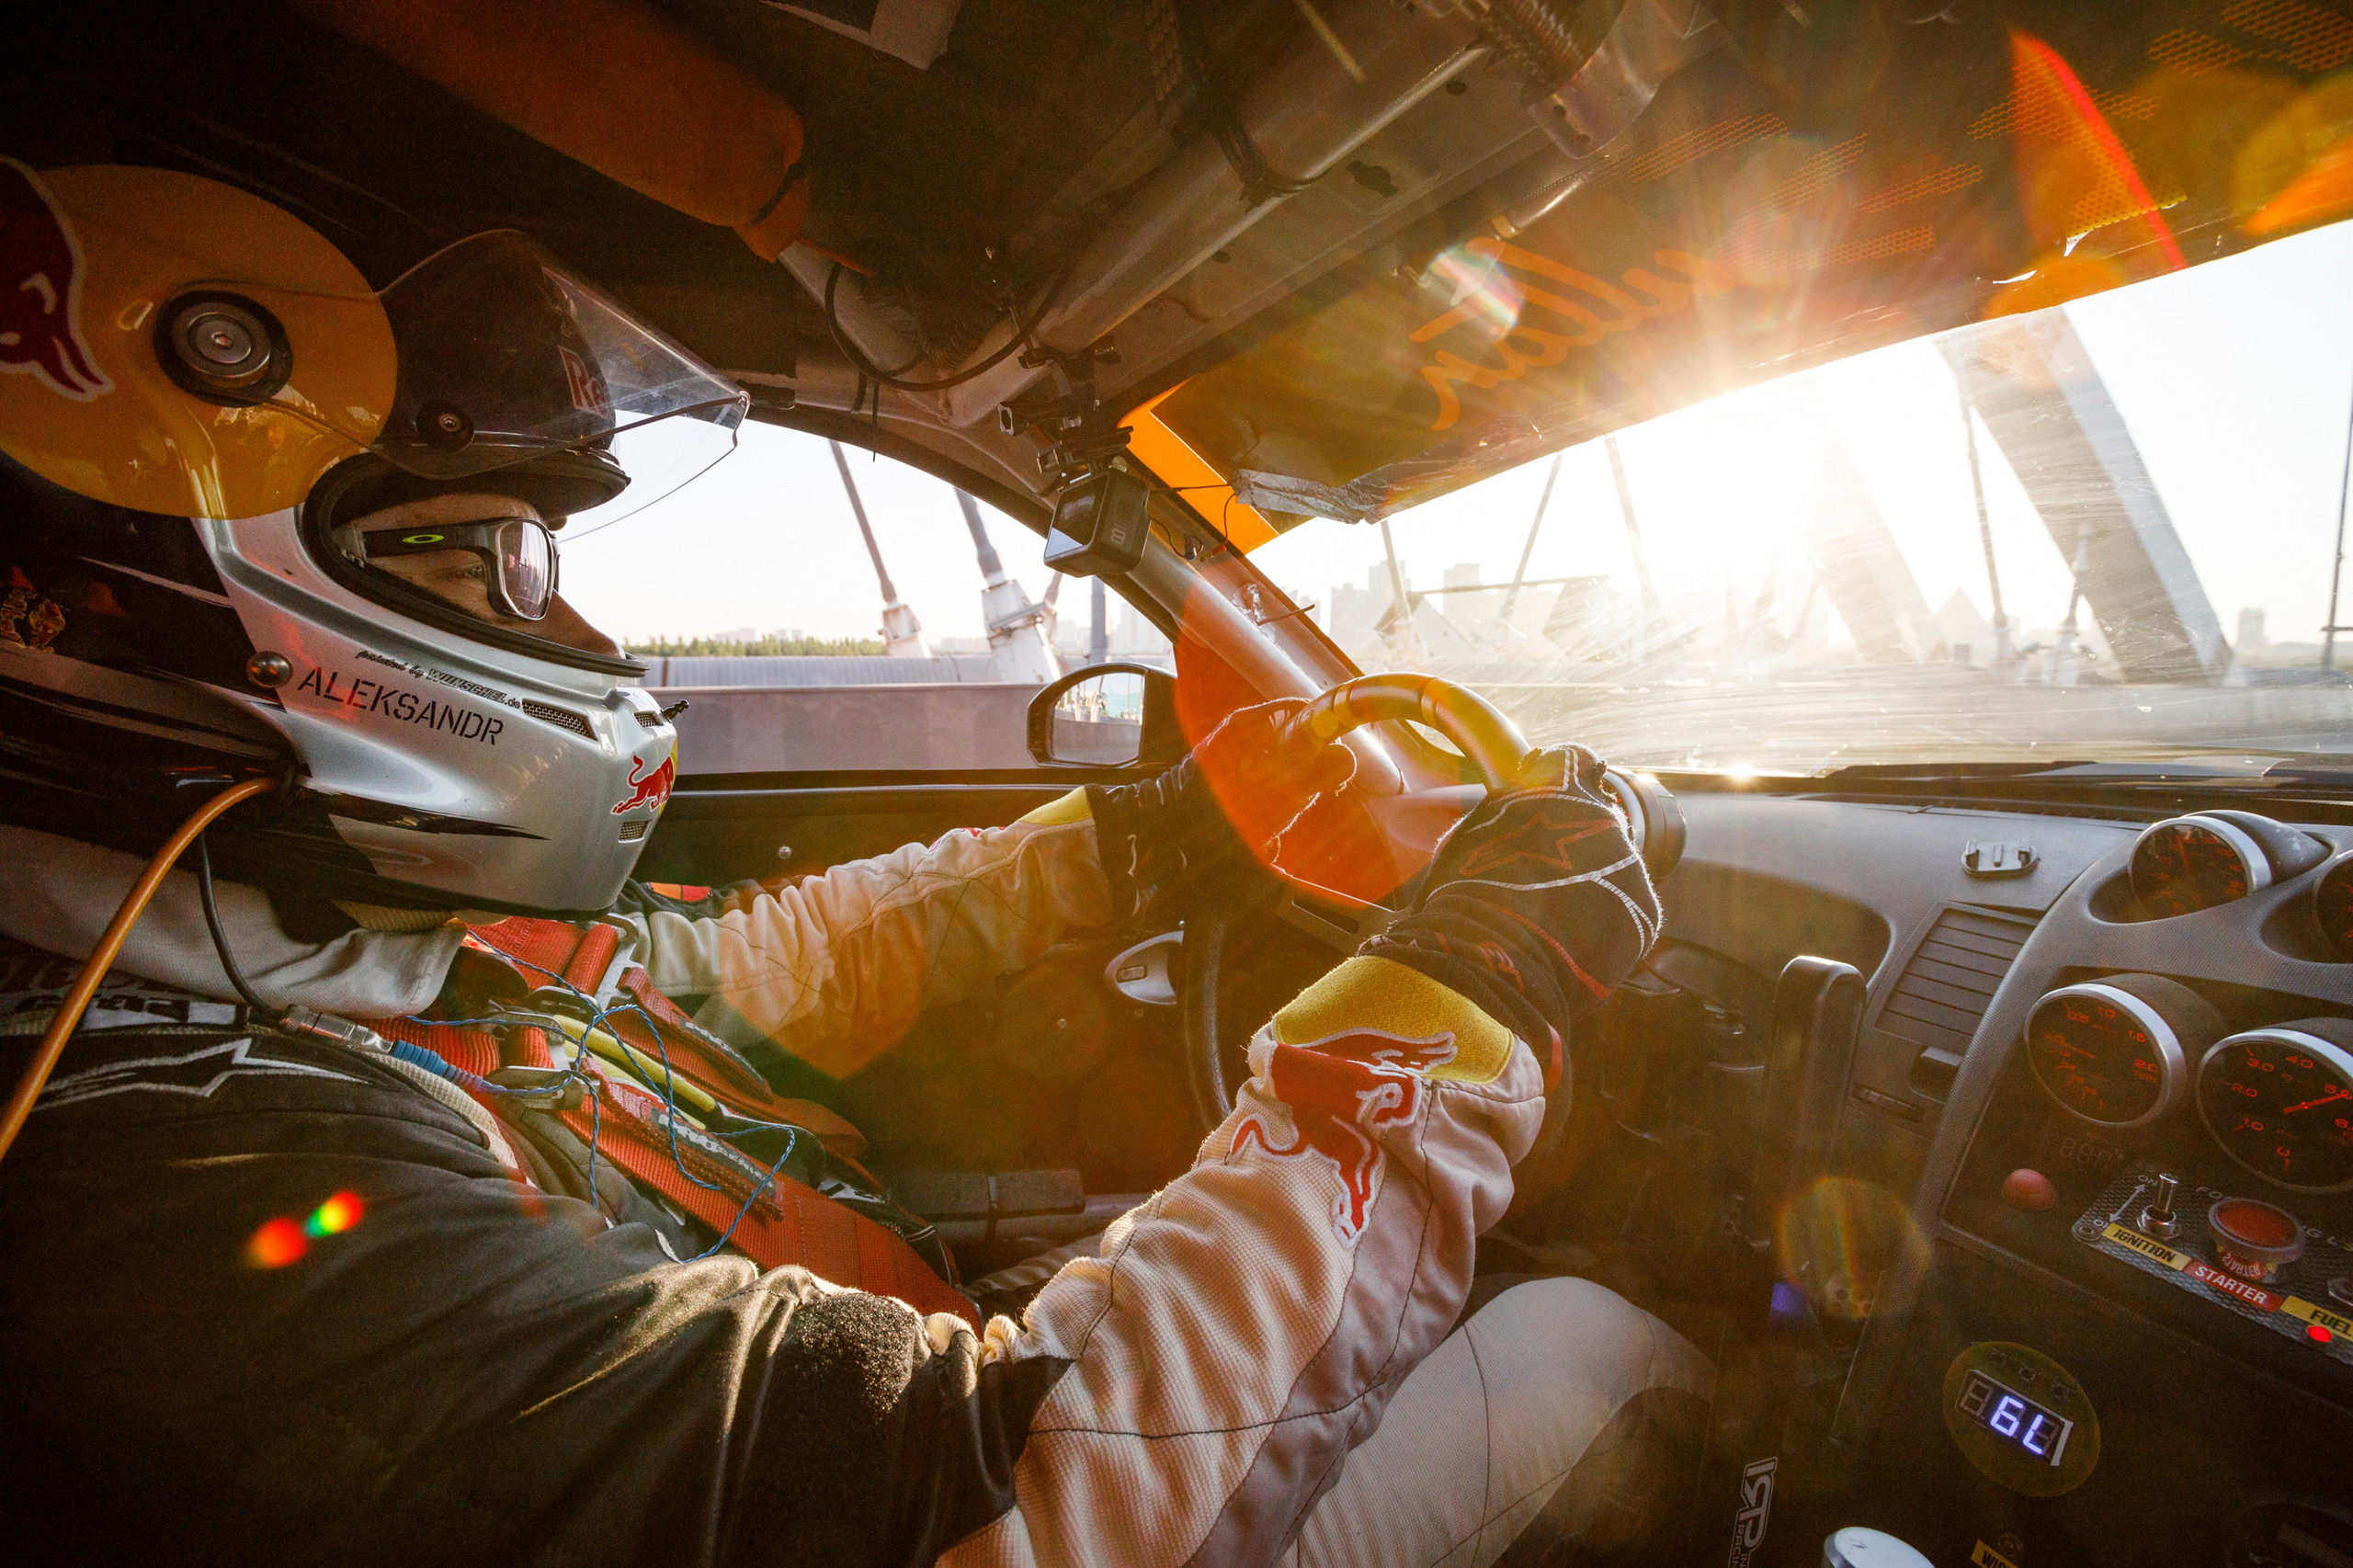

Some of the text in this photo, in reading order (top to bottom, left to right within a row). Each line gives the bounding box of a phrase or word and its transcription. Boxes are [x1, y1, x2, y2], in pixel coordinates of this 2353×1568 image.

[409, 664, 425, 678] by
[297, 665, 506, 746] ALEKSANDR
[2098, 1006, 2117, 1018] 1.0
[2246, 1057, 2275, 1073] 3.0
[2230, 1083, 2258, 1098] 2.0
[2243, 1118, 2265, 1131] 1.0
[2335, 1118, 2353, 1131] 6.
[2113, 1229, 2177, 1263] IGNITION
[2194, 1266, 2268, 1304] STARTER
[2310, 1309, 2351, 1336] FUEL
